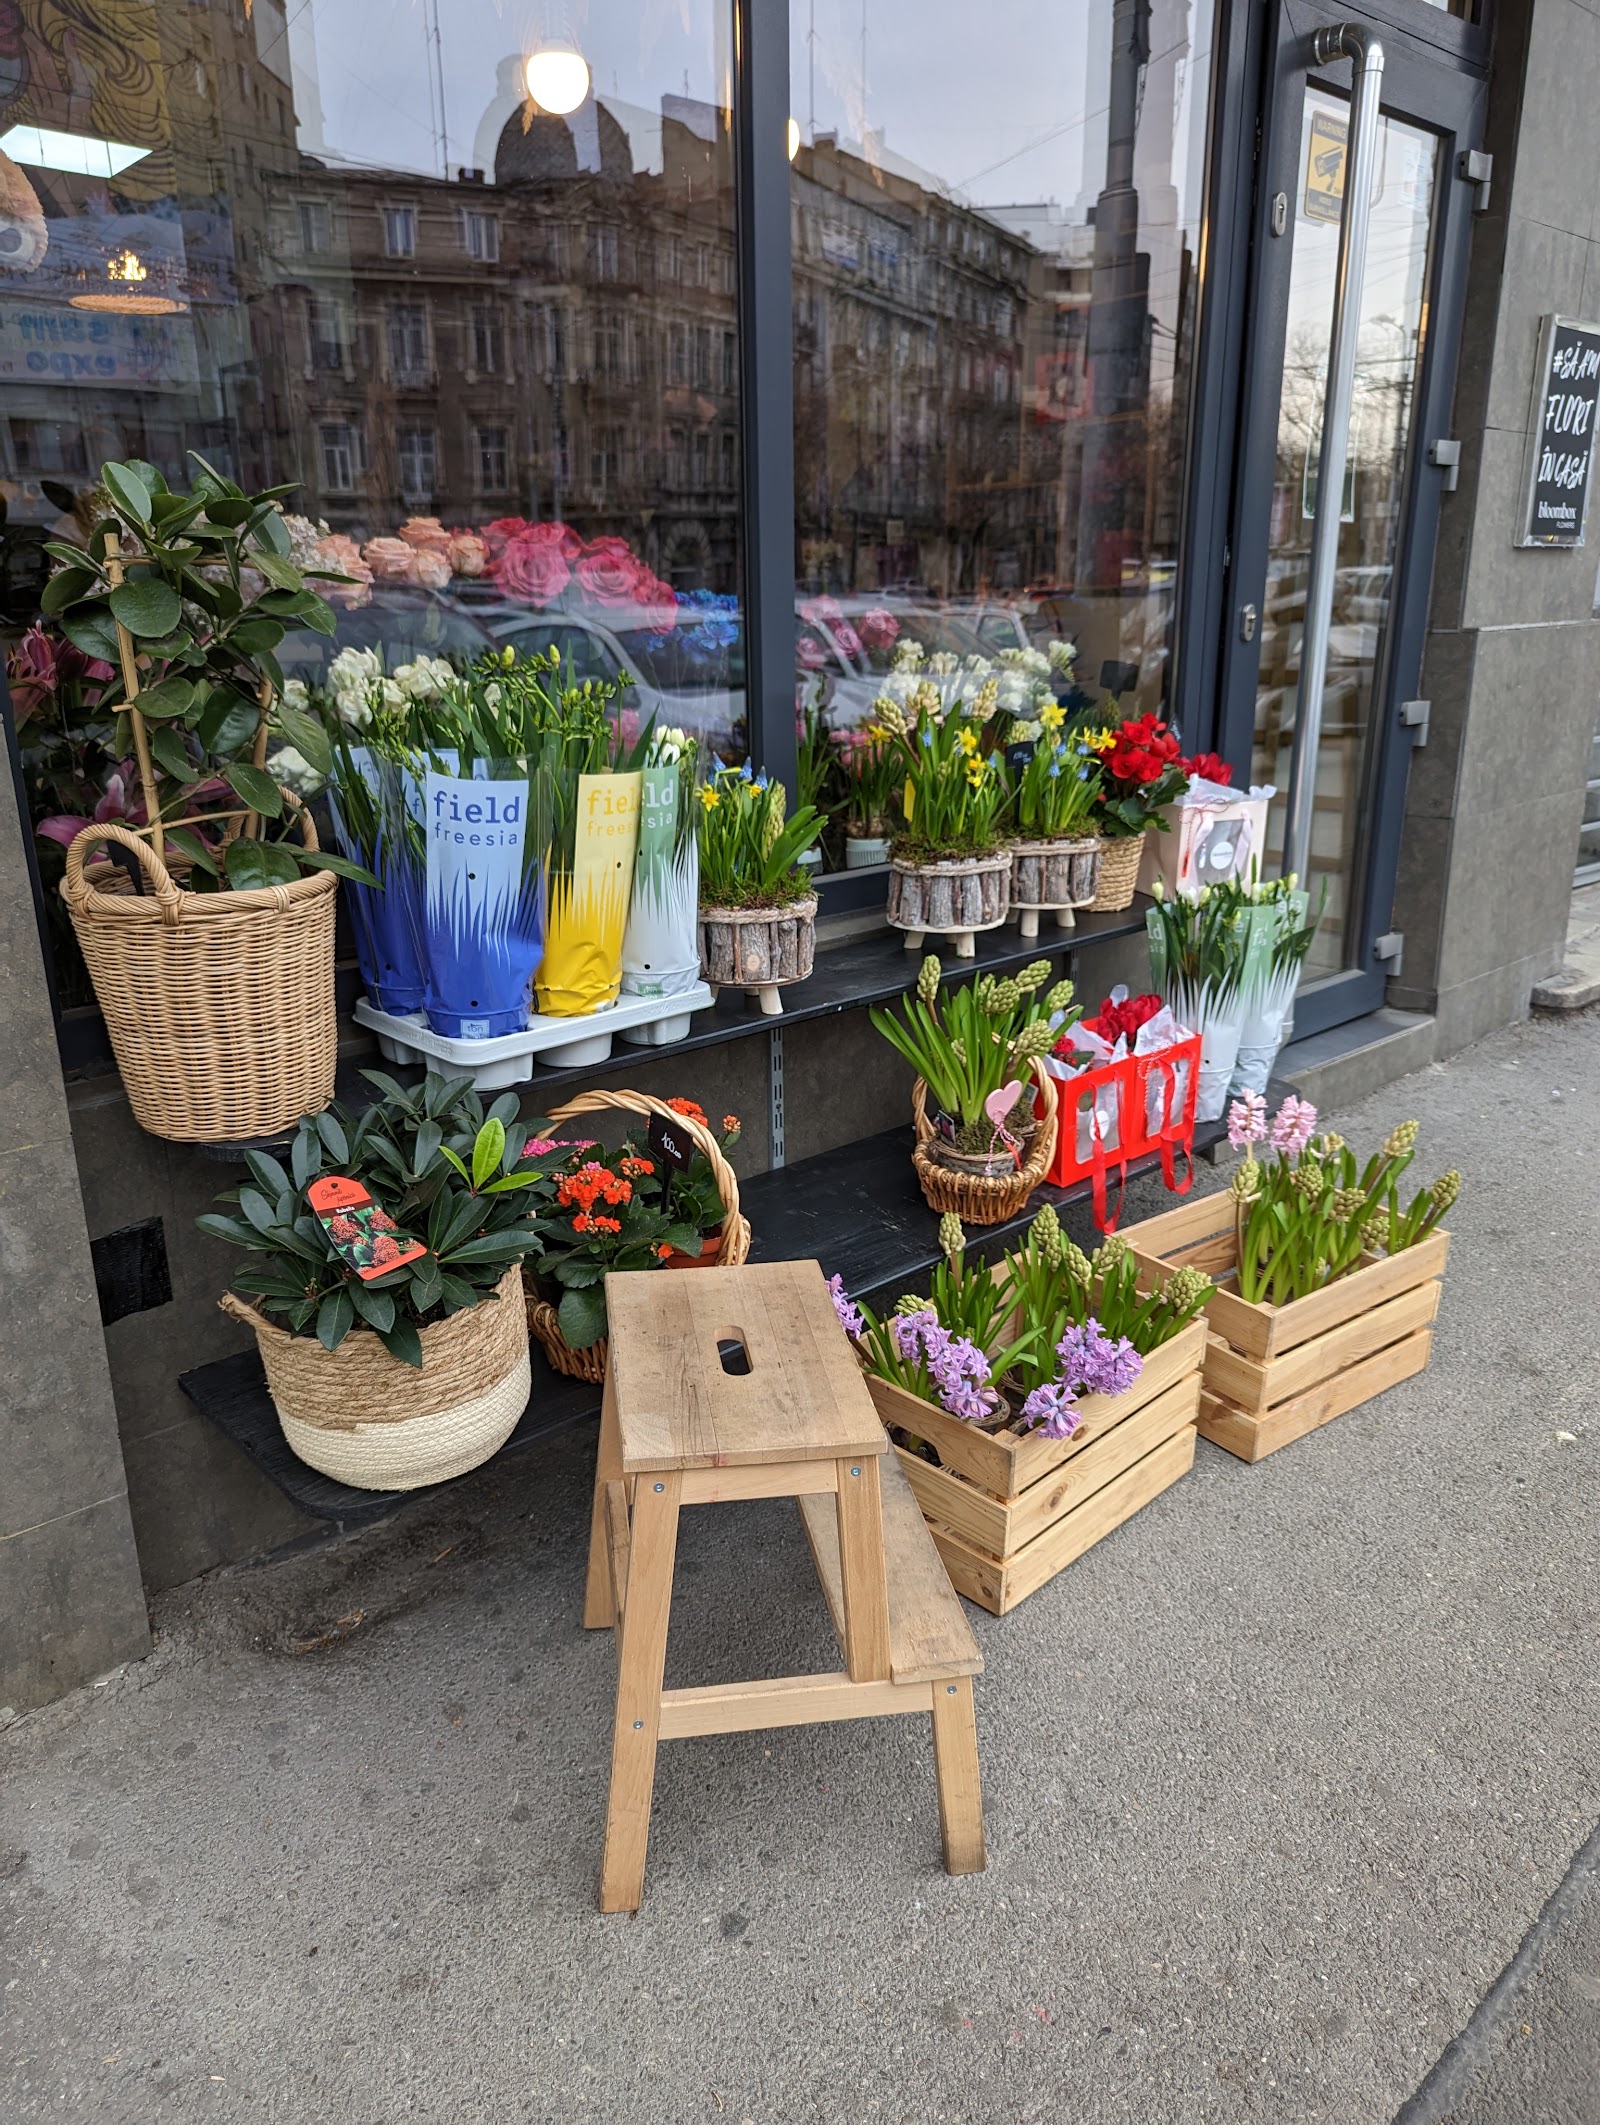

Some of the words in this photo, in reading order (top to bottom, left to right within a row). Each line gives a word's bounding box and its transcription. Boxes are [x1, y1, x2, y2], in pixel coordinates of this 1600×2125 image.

[1545, 394, 1594, 435] FLORI
[1538, 500, 1577, 519] bloombox
[434, 790, 520, 824] field
[587, 786, 637, 816] fiel
[435, 822, 518, 846] freesia
[587, 820, 633, 837] frees
